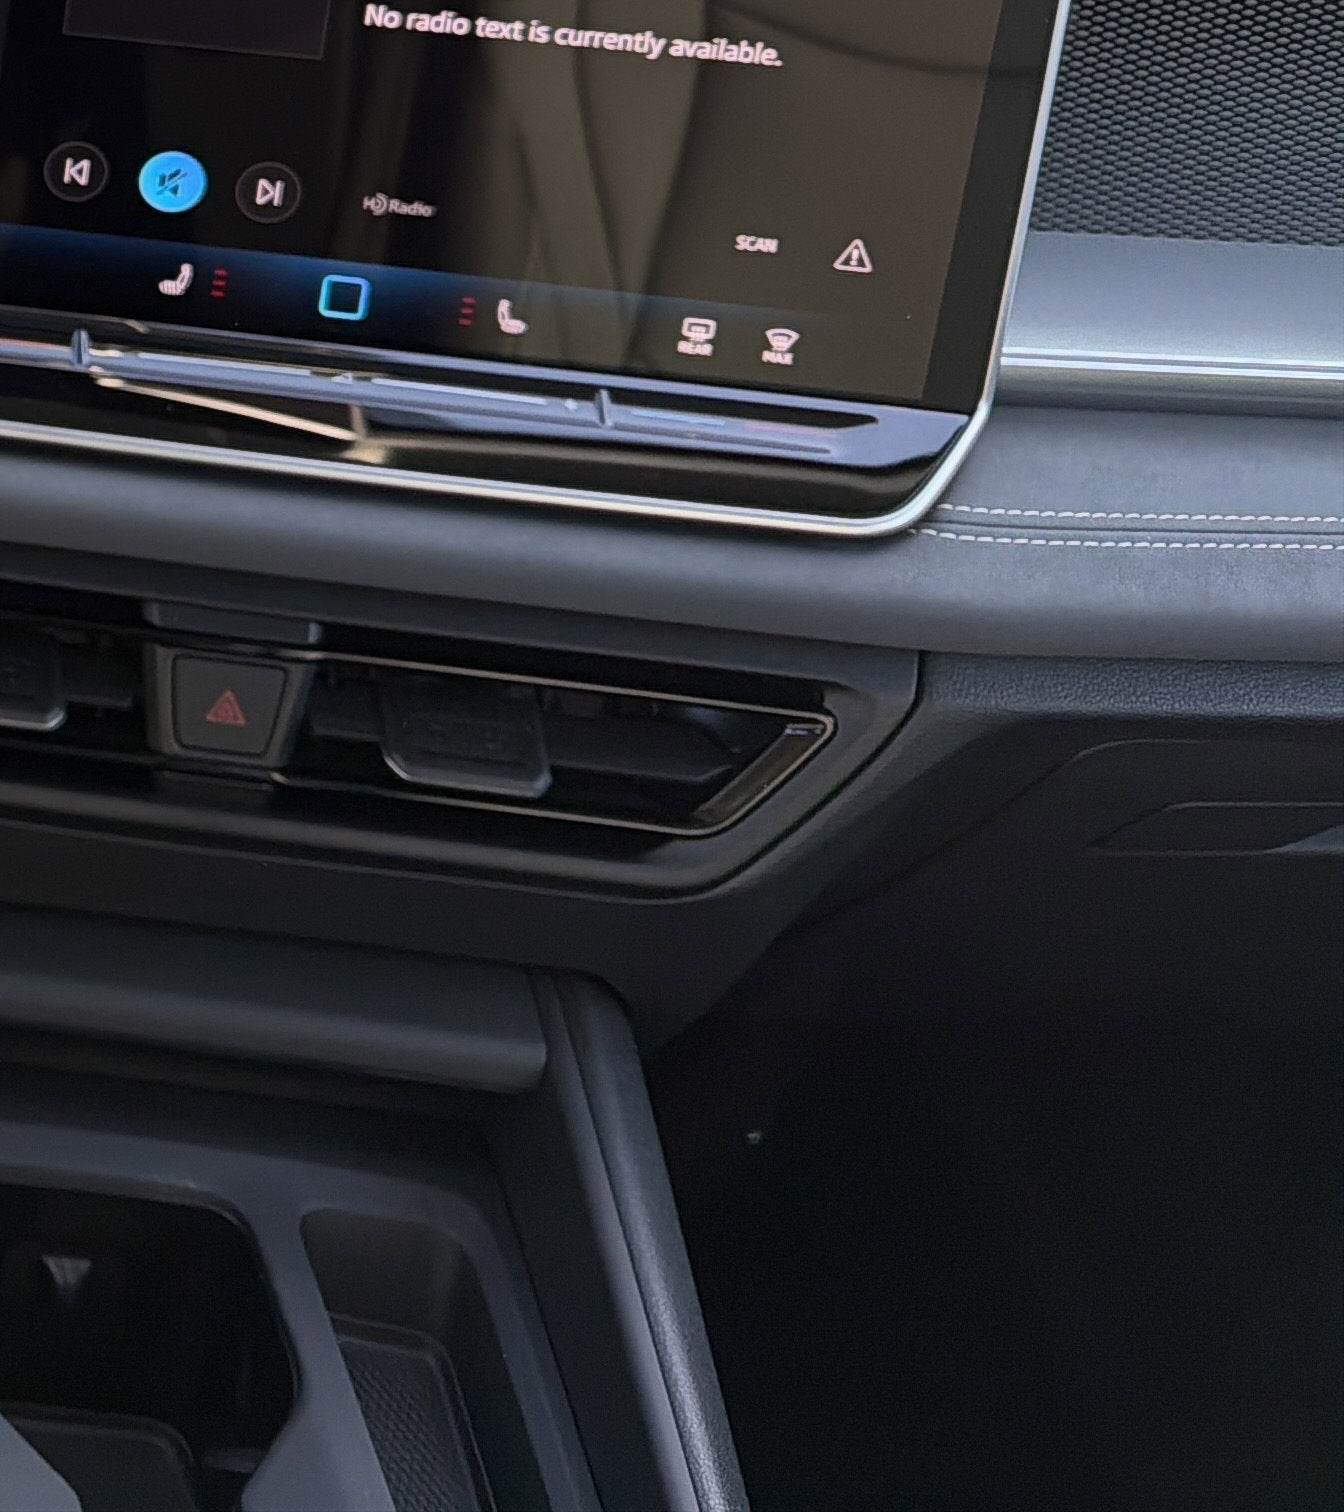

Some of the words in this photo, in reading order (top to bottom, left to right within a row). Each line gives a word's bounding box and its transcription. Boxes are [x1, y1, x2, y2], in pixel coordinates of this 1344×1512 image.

[364, 3, 403, 30] No
[406, 6, 471, 37] radio
[475, 15, 524, 42] text
[529, 18, 551, 43] is
[554, 22, 665, 59] currently
[669, 33, 783, 67] available.
[389, 198, 434, 218] Radio
[735, 234, 778, 254] SCAN
[677, 340, 713, 356] REAR
[762, 350, 794, 365] MAX
